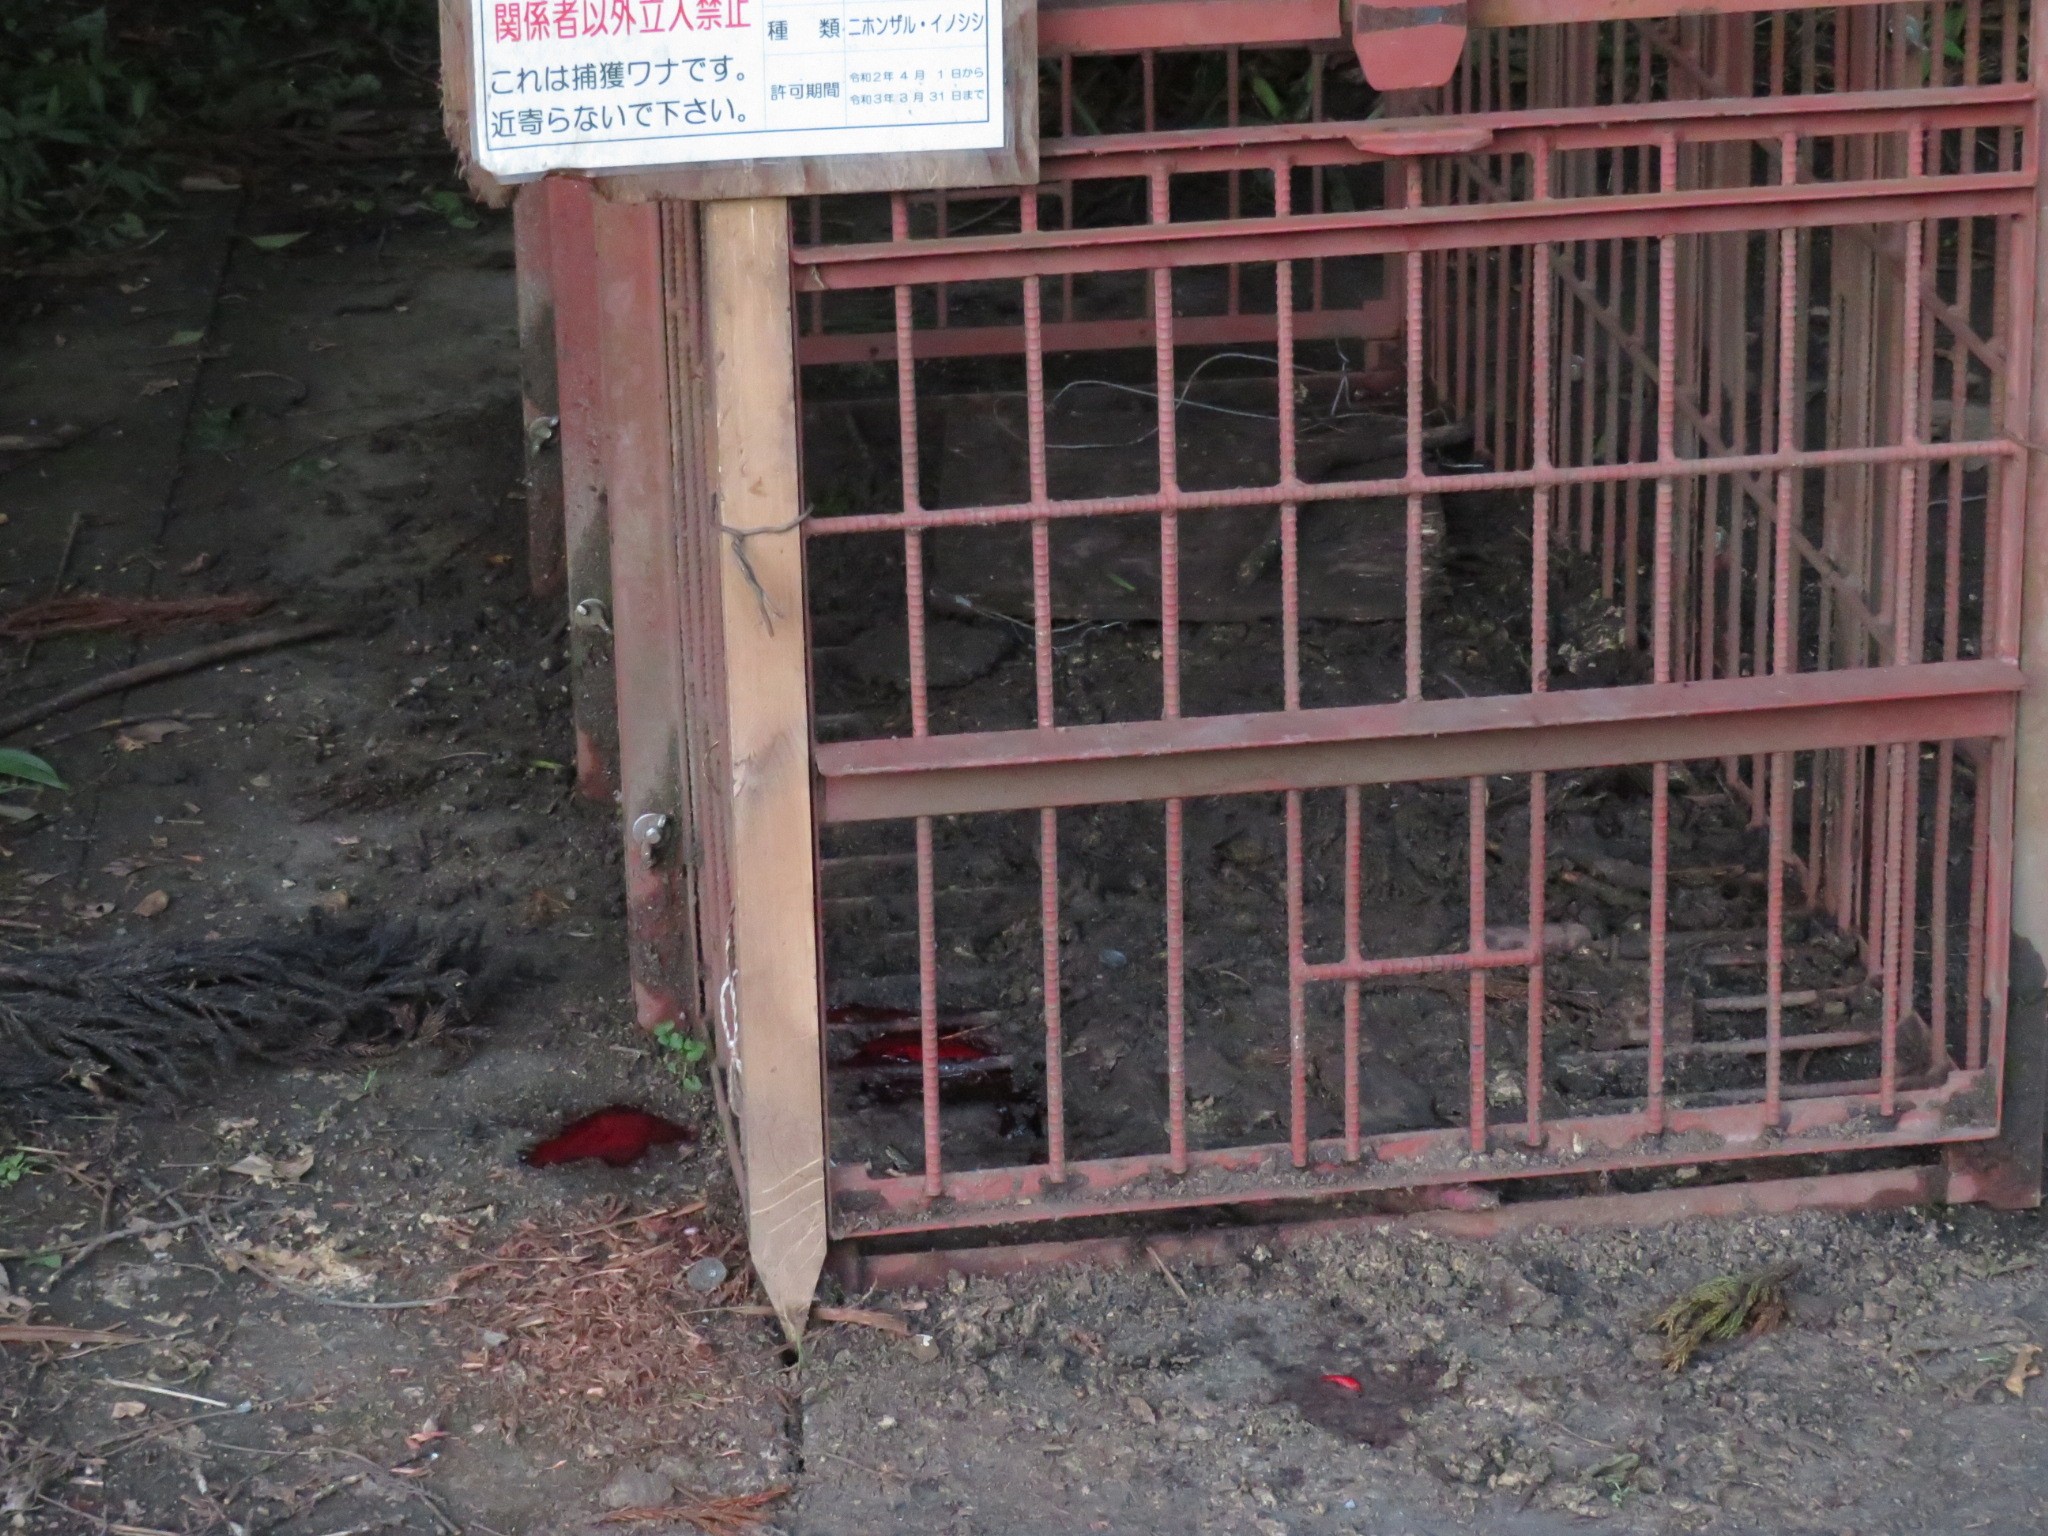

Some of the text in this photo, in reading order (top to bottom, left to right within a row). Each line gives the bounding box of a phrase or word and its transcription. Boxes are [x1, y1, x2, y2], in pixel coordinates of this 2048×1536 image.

[491, 54, 746, 95] これは捕獲ワナです。
[770, 81, 840, 101] 許可期間
[491, 98, 746, 138] 近寄らないで下さい。
